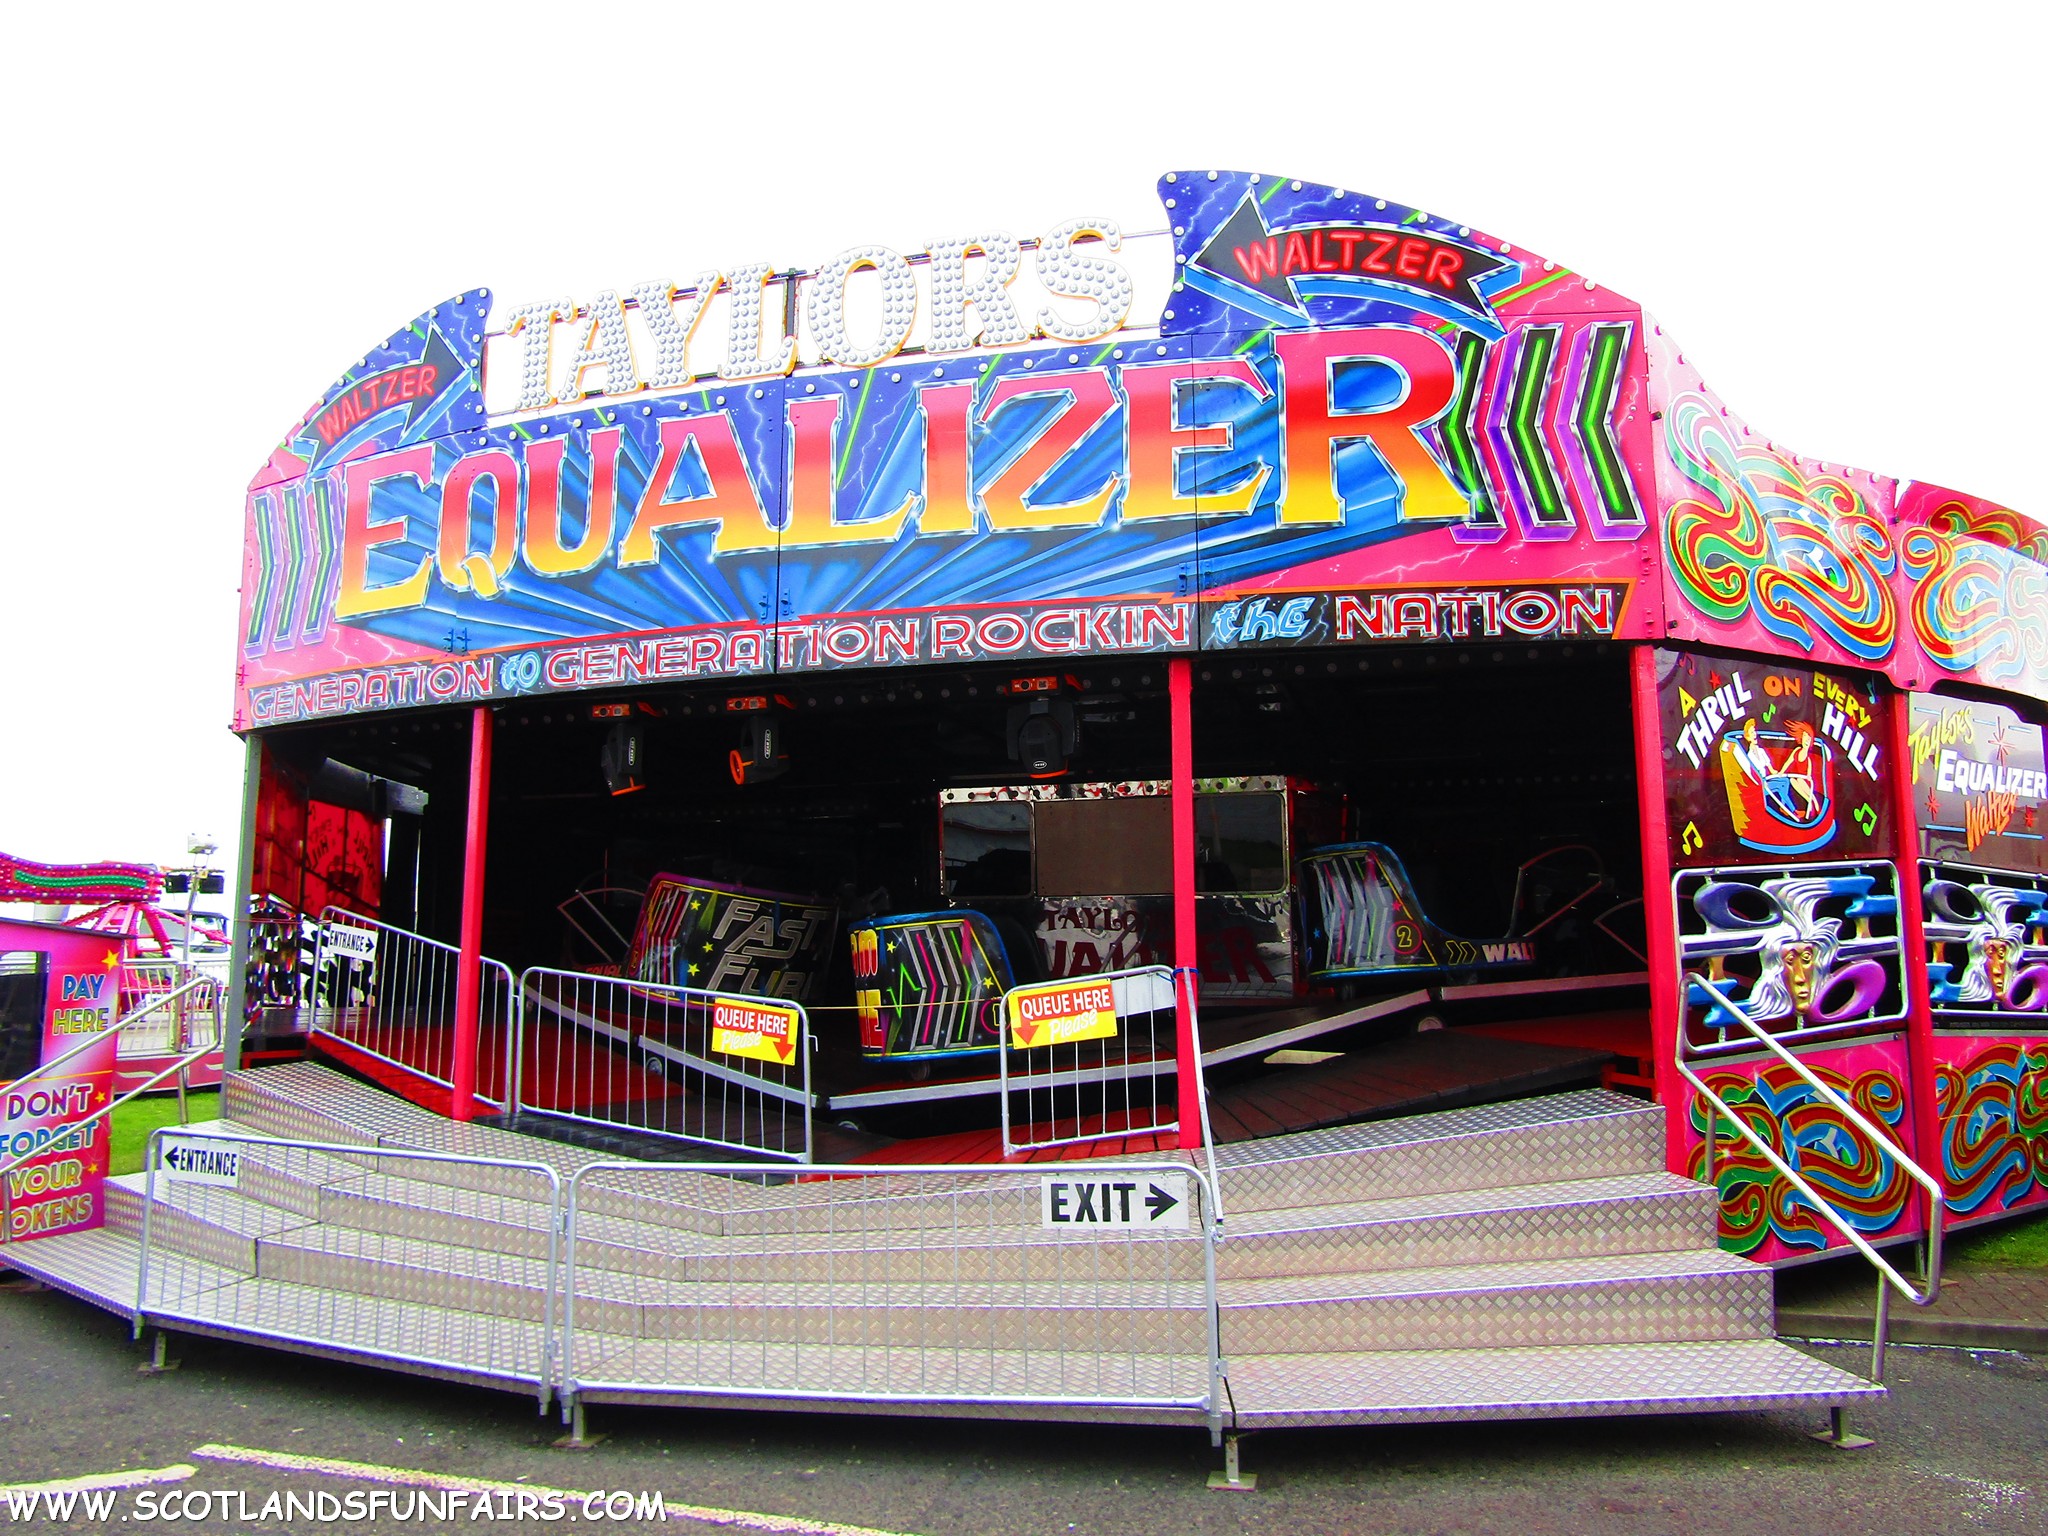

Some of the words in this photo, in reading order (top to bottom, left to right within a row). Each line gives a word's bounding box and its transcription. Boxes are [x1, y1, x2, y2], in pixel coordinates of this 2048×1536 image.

[1234, 230, 1462, 289] WALTZER
[505, 216, 1133, 412] TAYLORS
[316, 363, 438, 446] WALTZER
[334, 322, 1476, 622] EQUALIZER
[250, 657, 494, 721] GENERATION
[500, 653, 541, 691] to
[545, 618, 918, 688] GENERATION
[931, 602, 1190, 660] ROCKIN
[1212, 596, 1314, 643] the
[1336, 588, 1613, 640] NATION
[1677, 685, 1697, 719] A
[1763, 675, 1801, 699] ON
[1812, 670, 1873, 730] EVERY
[1676, 671, 1753, 770] THRILL
[1820, 704, 1881, 782] HILL
[1936, 748, 2048, 800] EQUALIZER
[329, 930, 365, 953] ENTRANCE
[712, 899, 831, 960] FAST
[1396, 925, 1413, 949] 2
[62, 974, 106, 1002] PAY
[1021, 994, 1071, 1018] QUEUE
[1073, 988, 1111, 1010] HERE
[52, 1006, 109, 1036] HERE
[715, 1006, 755, 1031] QUEUE
[756, 1012, 788, 1036] HERE
[720, 1029, 764, 1051] Please
[1049, 1009, 1098, 1041] Please
[6, 1084, 93, 1122] DON'T
[9, 1158, 82, 1199] YOUR
[180, 1147, 238, 1177] ENTRANCE
[0, 1193, 92, 1239] OKENS
[1050, 1182, 1137, 1223] EXIT
